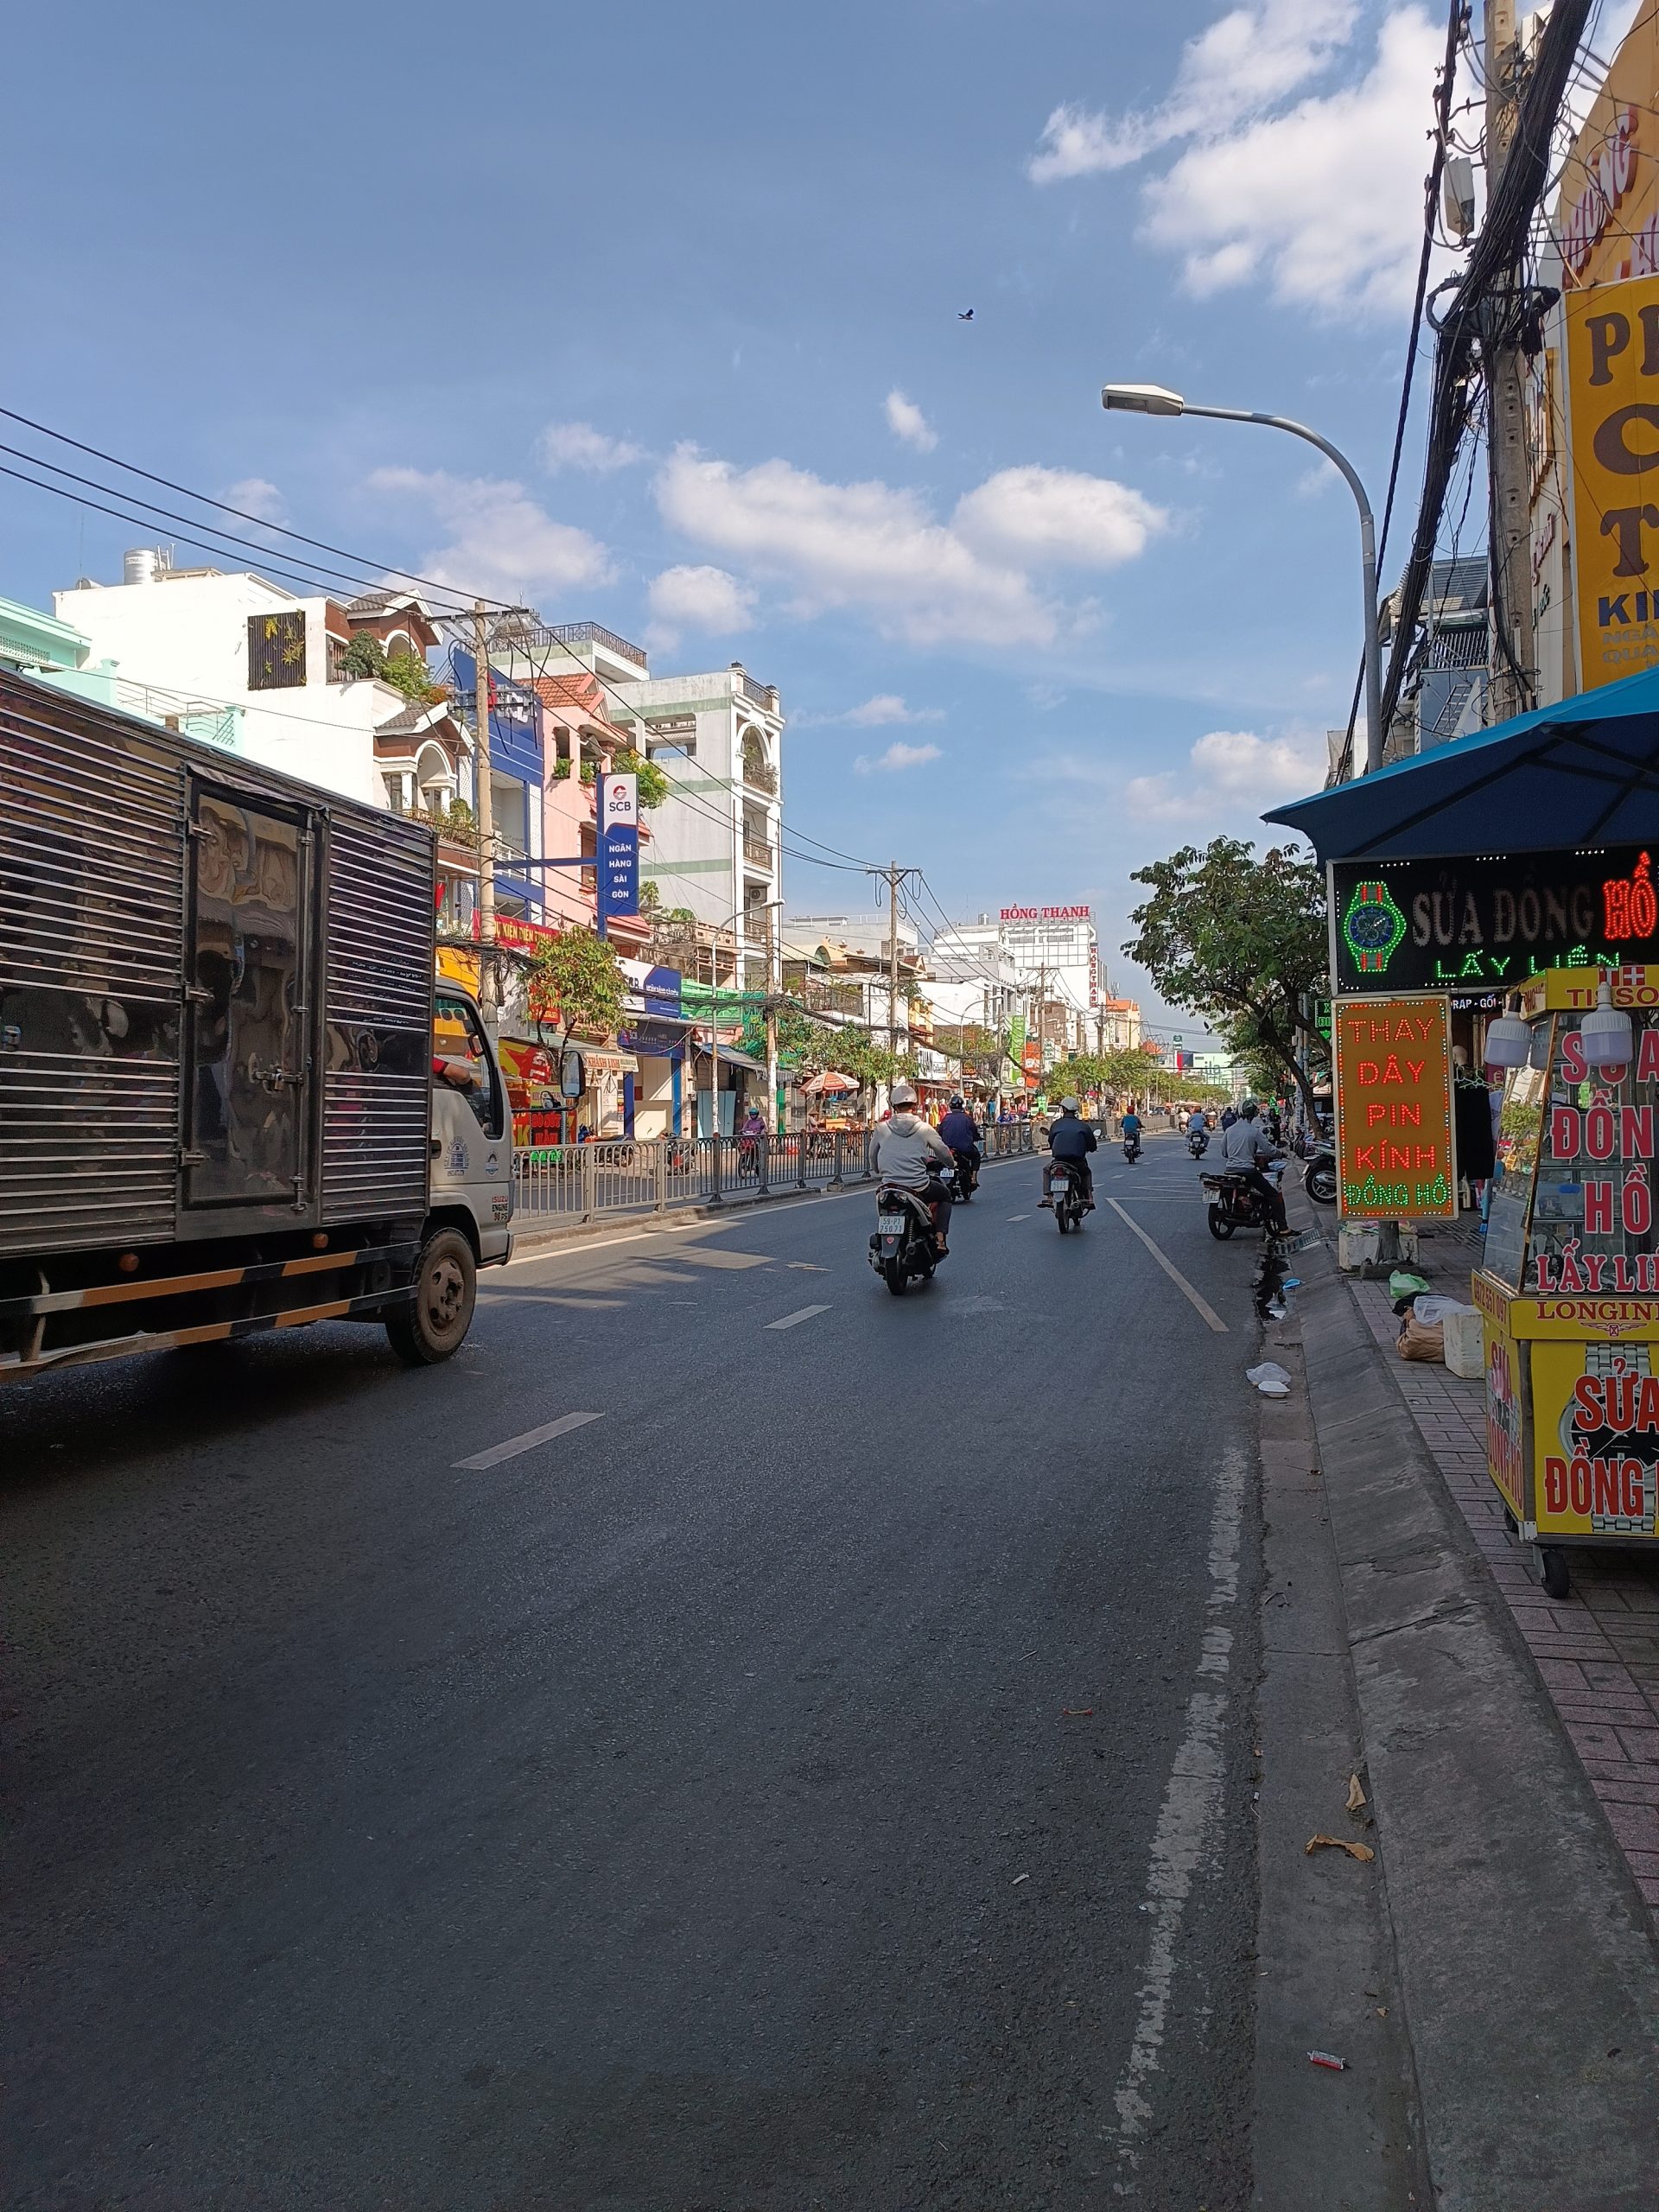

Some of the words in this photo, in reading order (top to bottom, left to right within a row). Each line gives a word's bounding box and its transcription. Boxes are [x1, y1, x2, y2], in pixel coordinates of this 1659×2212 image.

[1599, 589, 1659, 627] KI
[608, 801, 632, 812] SCB
[608, 843, 632, 854] NGÂN
[608, 858, 632, 868] HÀNG
[613, 874, 627, 884] SÀI
[612, 890, 629, 899] GÒN
[1000, 903, 1039, 920] HỒNG
[1436, 949, 1510, 978] LẤY
[1450, 998, 1471, 1009] RAP
[1566, 986, 1659, 1007] TISO
[1346, 1017, 1435, 1043] THAY
[1357, 1054, 1426, 1086] DÂY
[1367, 1103, 1422, 1128] PIN
[1355, 1138, 1436, 1170] KÍNH
[1584, 1162, 1651, 1236] HỒ
[1535, 1238, 1607, 1292] LẤY
[1574, 1356, 1659, 1433] SỬA
[1544, 1437, 1645, 1518] ĐỒNG
